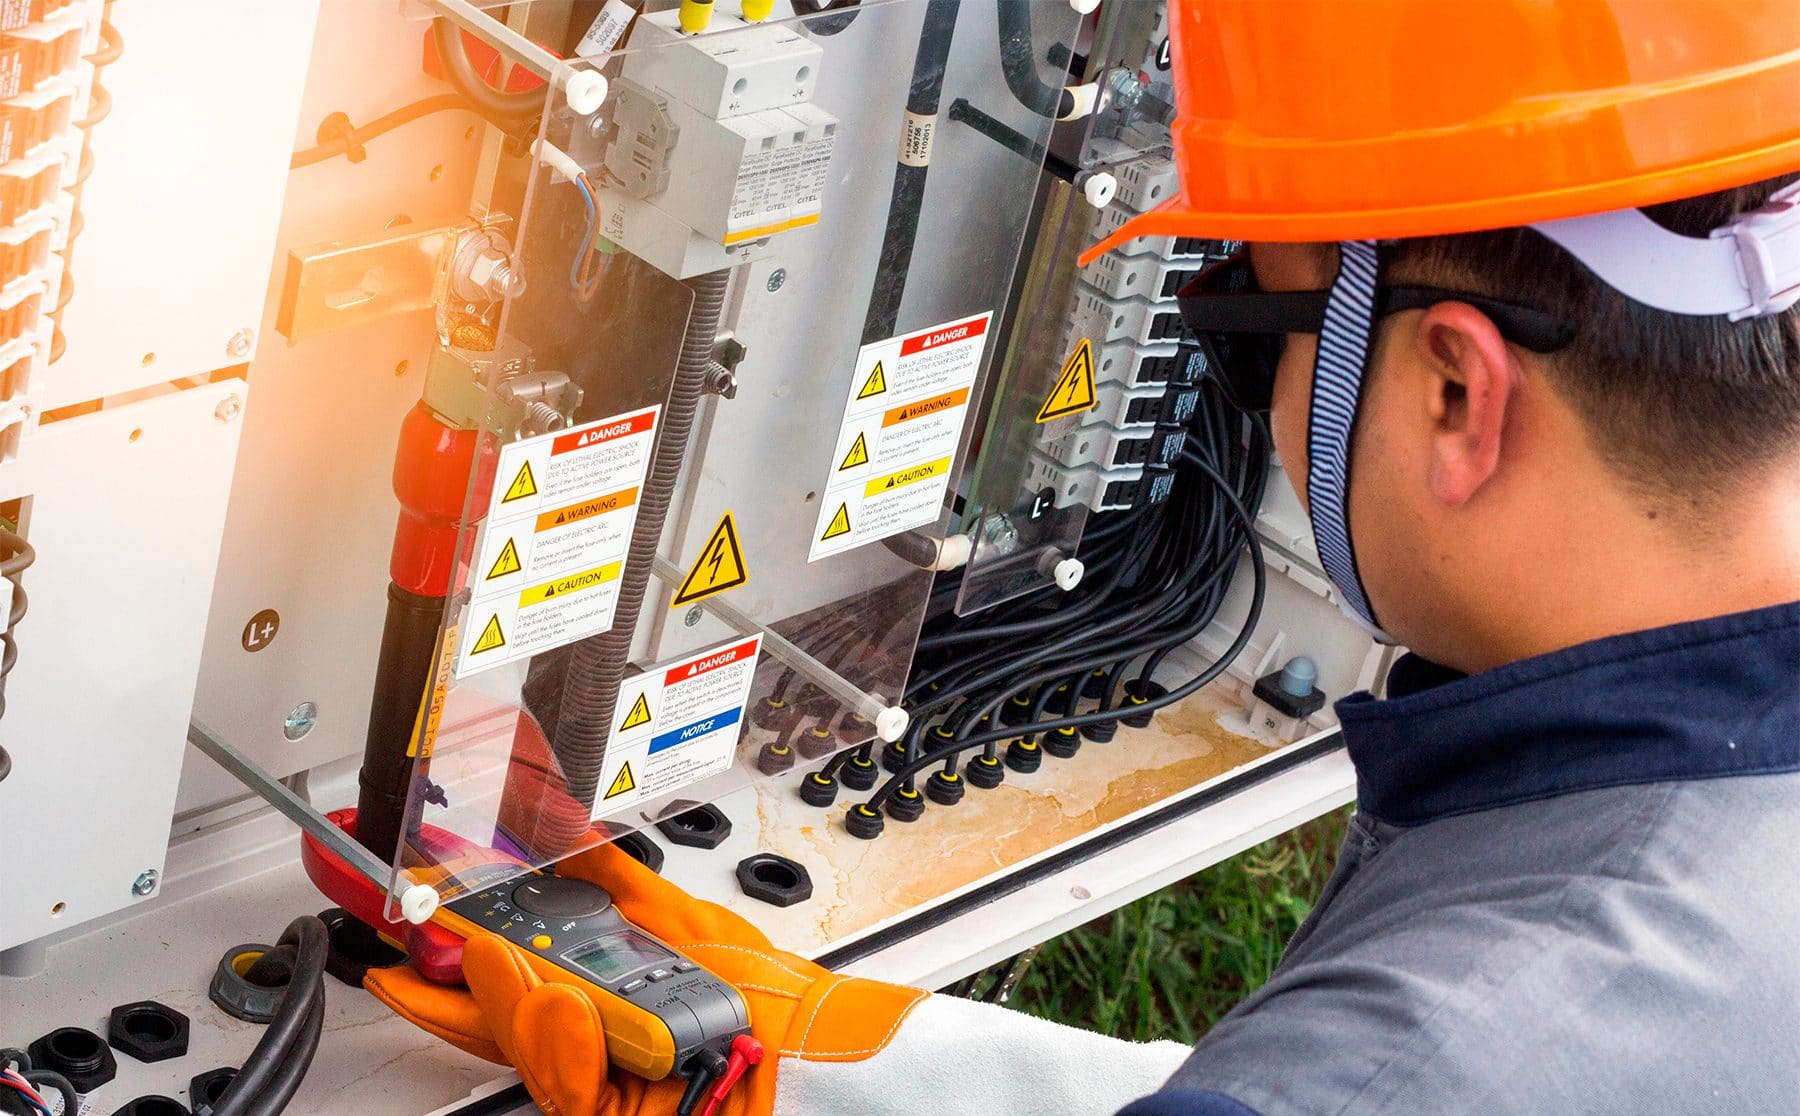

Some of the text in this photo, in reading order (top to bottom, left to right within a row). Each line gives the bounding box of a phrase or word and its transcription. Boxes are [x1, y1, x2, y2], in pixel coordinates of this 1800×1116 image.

[1160, 40, 1170, 64] L
[766, 203, 787, 212] CITEL
[798, 195, 817, 204] CITEL
[734, 210, 755, 219] CITEL
[932, 326, 967, 344] DANGER
[909, 396, 950, 416] WARNING
[589, 422, 631, 441] DANGER
[547, 448, 635, 479] DUE TO ACTIVE POWER SOURCE
[562, 458, 571, 467] OF
[572, 453, 591, 464] LETHAL
[592, 446, 617, 458] ELECTRIC
[618, 440, 638, 451] SHOCK
[896, 466, 933, 483] CAUTION
[568, 497, 616, 519] WARNING
[1032, 496, 1049, 518] L-
[536, 521, 608, 548] DANGER OF ELECTRIC ARC
[557, 571, 601, 592] CAUTION
[248, 622, 274, 646] L+
[698, 650, 736, 671] DANGER
[680, 719, 714, 739] NOTICE
[1265, 718, 1275, 728] 20
[562, 921, 576, 932] OFF
[656, 996, 680, 1008] COM
